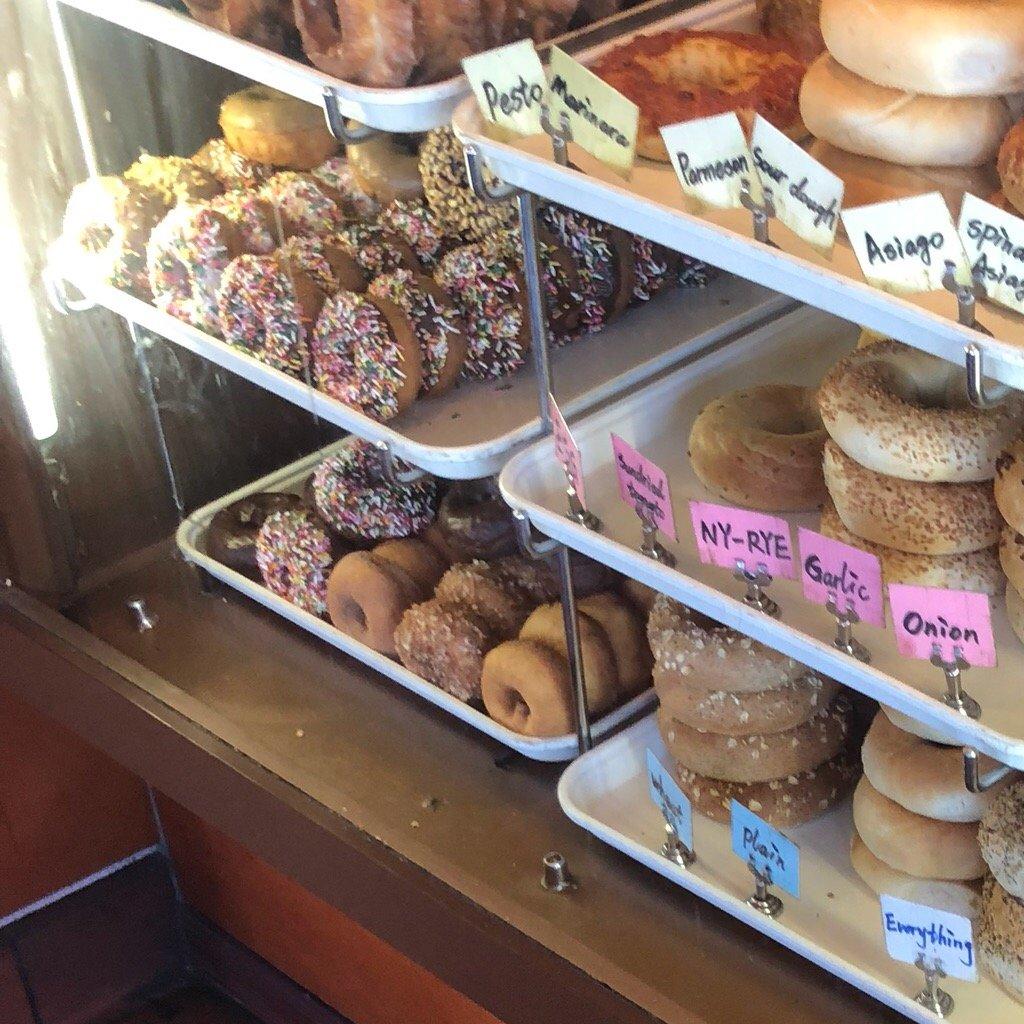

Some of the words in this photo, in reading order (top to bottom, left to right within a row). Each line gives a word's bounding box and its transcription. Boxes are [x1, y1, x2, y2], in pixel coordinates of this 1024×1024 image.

[482, 80, 543, 121] Pesto
[676, 151, 750, 186] Parmesan
[753, 146, 789, 183] Sour
[864, 231, 944, 266] Asiago
[701, 520, 792, 560] NY-RYE
[804, 553, 870, 601] Garlic
[902, 610, 980, 645] Onion
[743, 826, 786, 872] Plain
